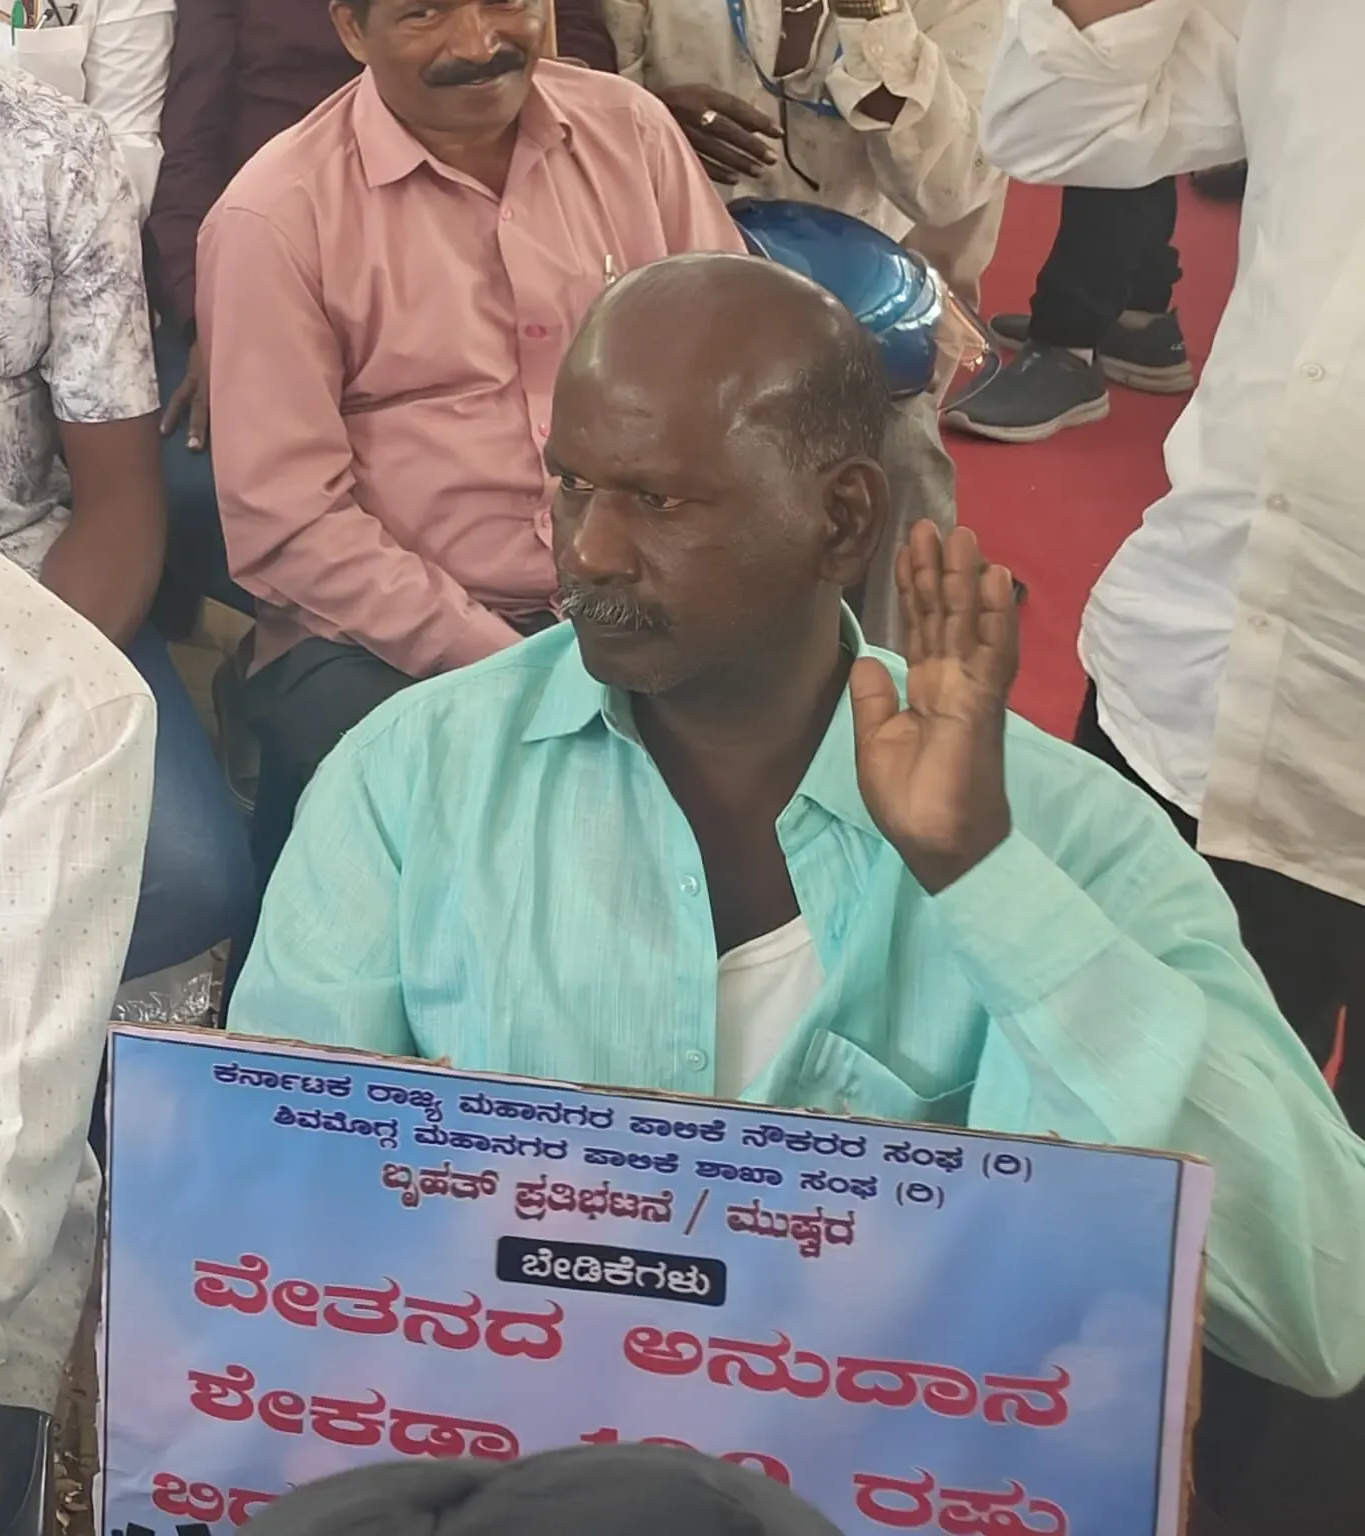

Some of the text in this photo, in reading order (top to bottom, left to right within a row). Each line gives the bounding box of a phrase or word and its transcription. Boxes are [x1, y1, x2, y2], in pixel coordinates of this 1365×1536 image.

[213, 1062, 1033, 1183] ಕರ್ನಾಟಕ ರಾಜ್ಯ ಮಹಾನಗರ ಪಾಲಿಕೆ ನೌಕರರ ಸಂಘ (ರಿ)
[273, 1105, 946, 1210] ಶಿವಮೊಗ್ಗ ಮಹಾನಗರ ಪಾಲಿಕೆ ಶಾಖಾ ಸಂಘ (ರಿ)
[381, 1161, 500, 1208] ಬೃಹತ್
[726, 1197, 856, 1259] ಮುಷ್ಕರ
[521, 1248, 711, 1296] ಬೇಡಿಕೆಗಳು
[192, 1252, 1071, 1429] ವೇತನದ ಅನುದಾನ
